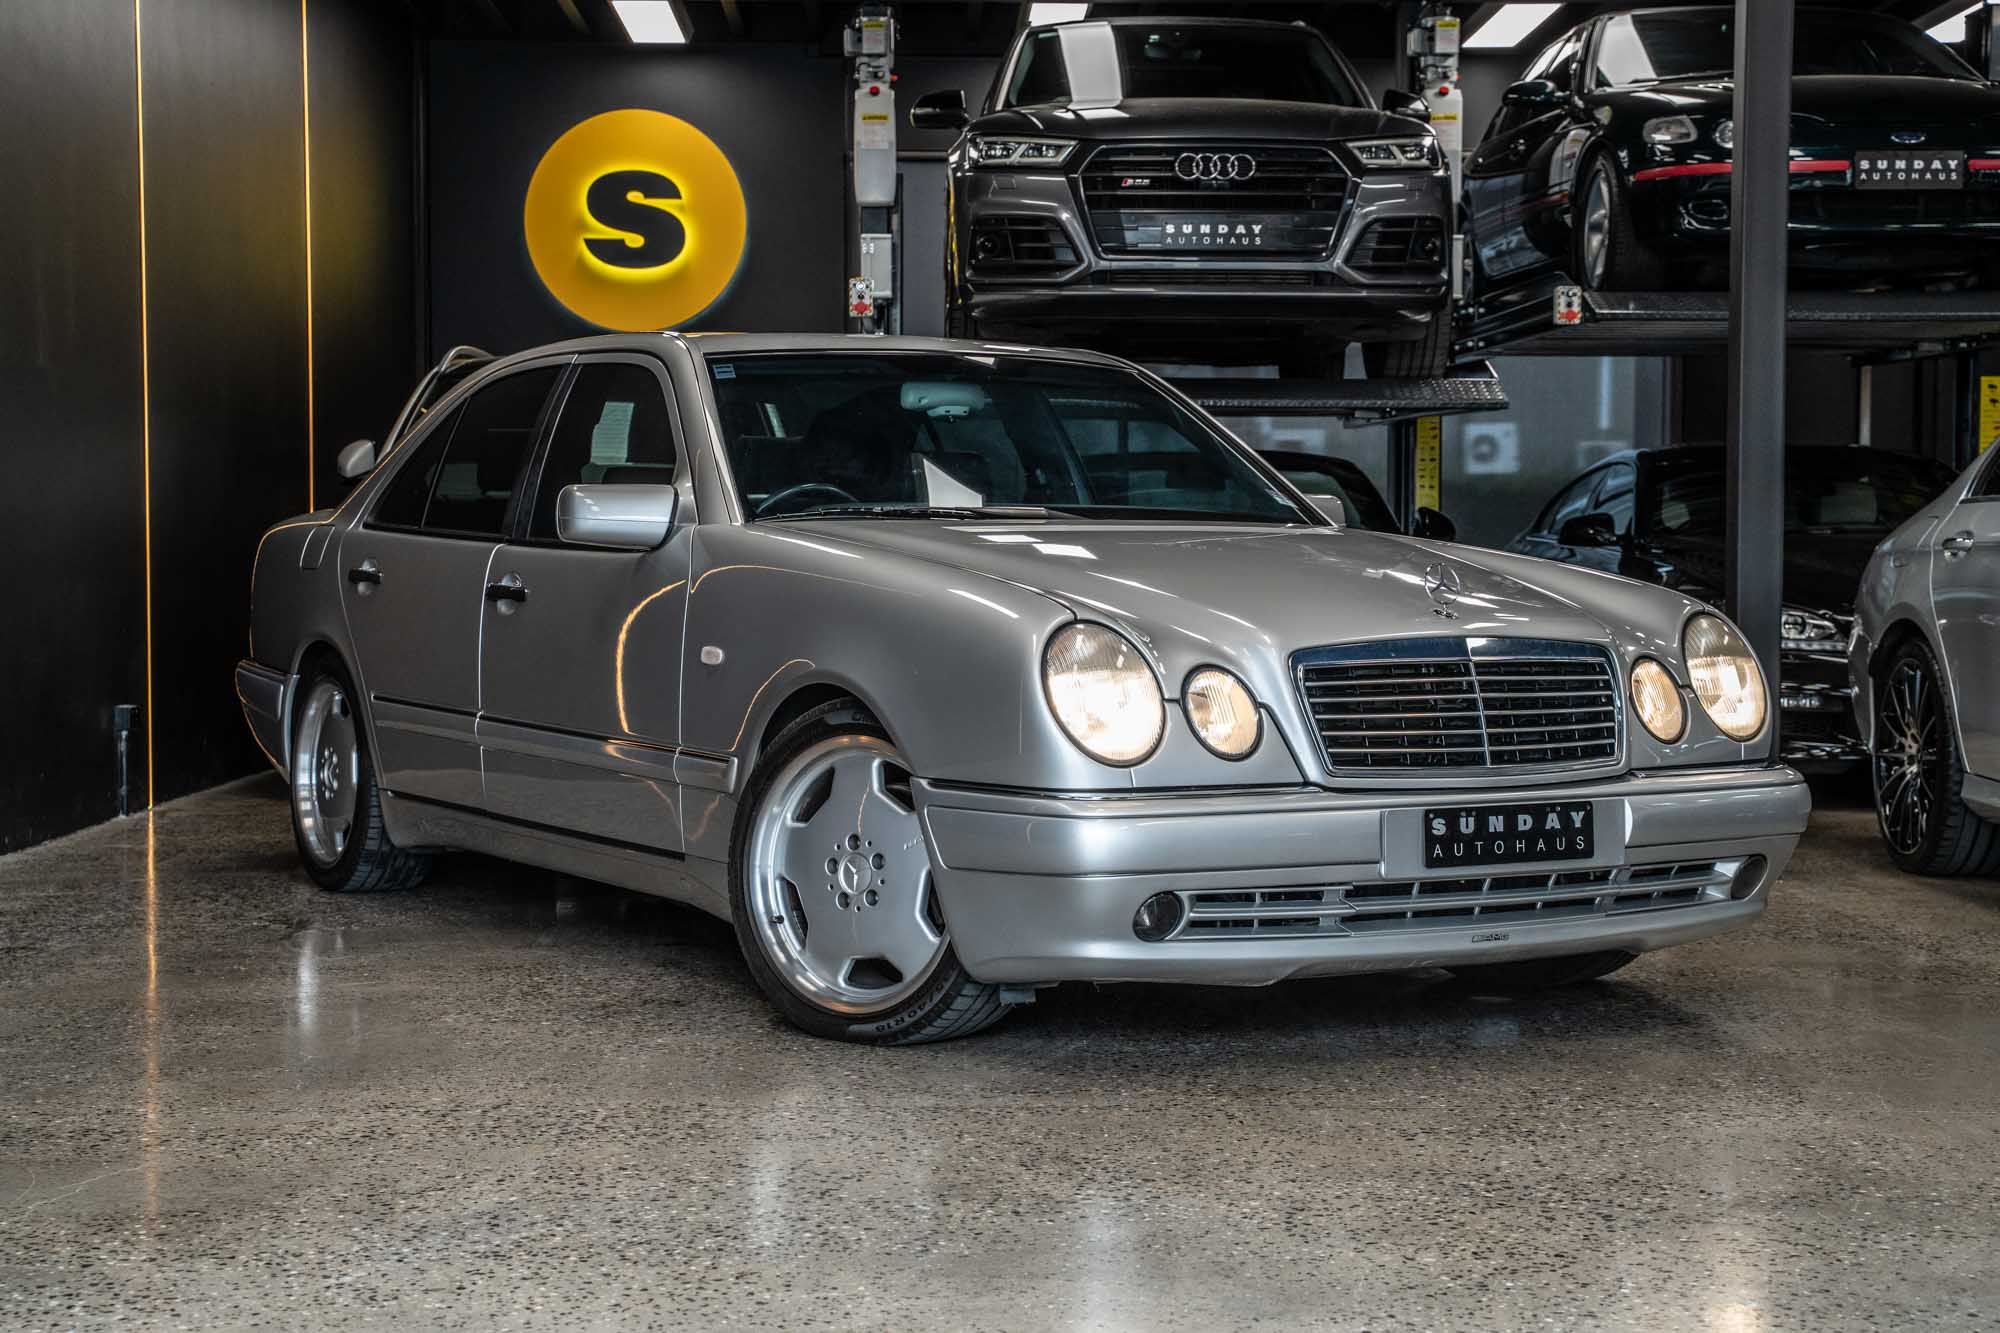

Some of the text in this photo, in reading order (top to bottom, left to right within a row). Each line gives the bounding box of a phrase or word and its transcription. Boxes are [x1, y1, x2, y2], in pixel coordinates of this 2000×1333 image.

[1860, 159, 1958, 170] SUNDAY
[1860, 171, 1958, 180] AUTOHAUS
[583, 170, 686, 268] S
[1165, 224, 1263, 234] SUNDAY
[1166, 237, 1262, 245] AUTOHAUS
[1431, 811, 1585, 836] SUNDAY
[1433, 836, 1585, 858] AUTOHAUS
